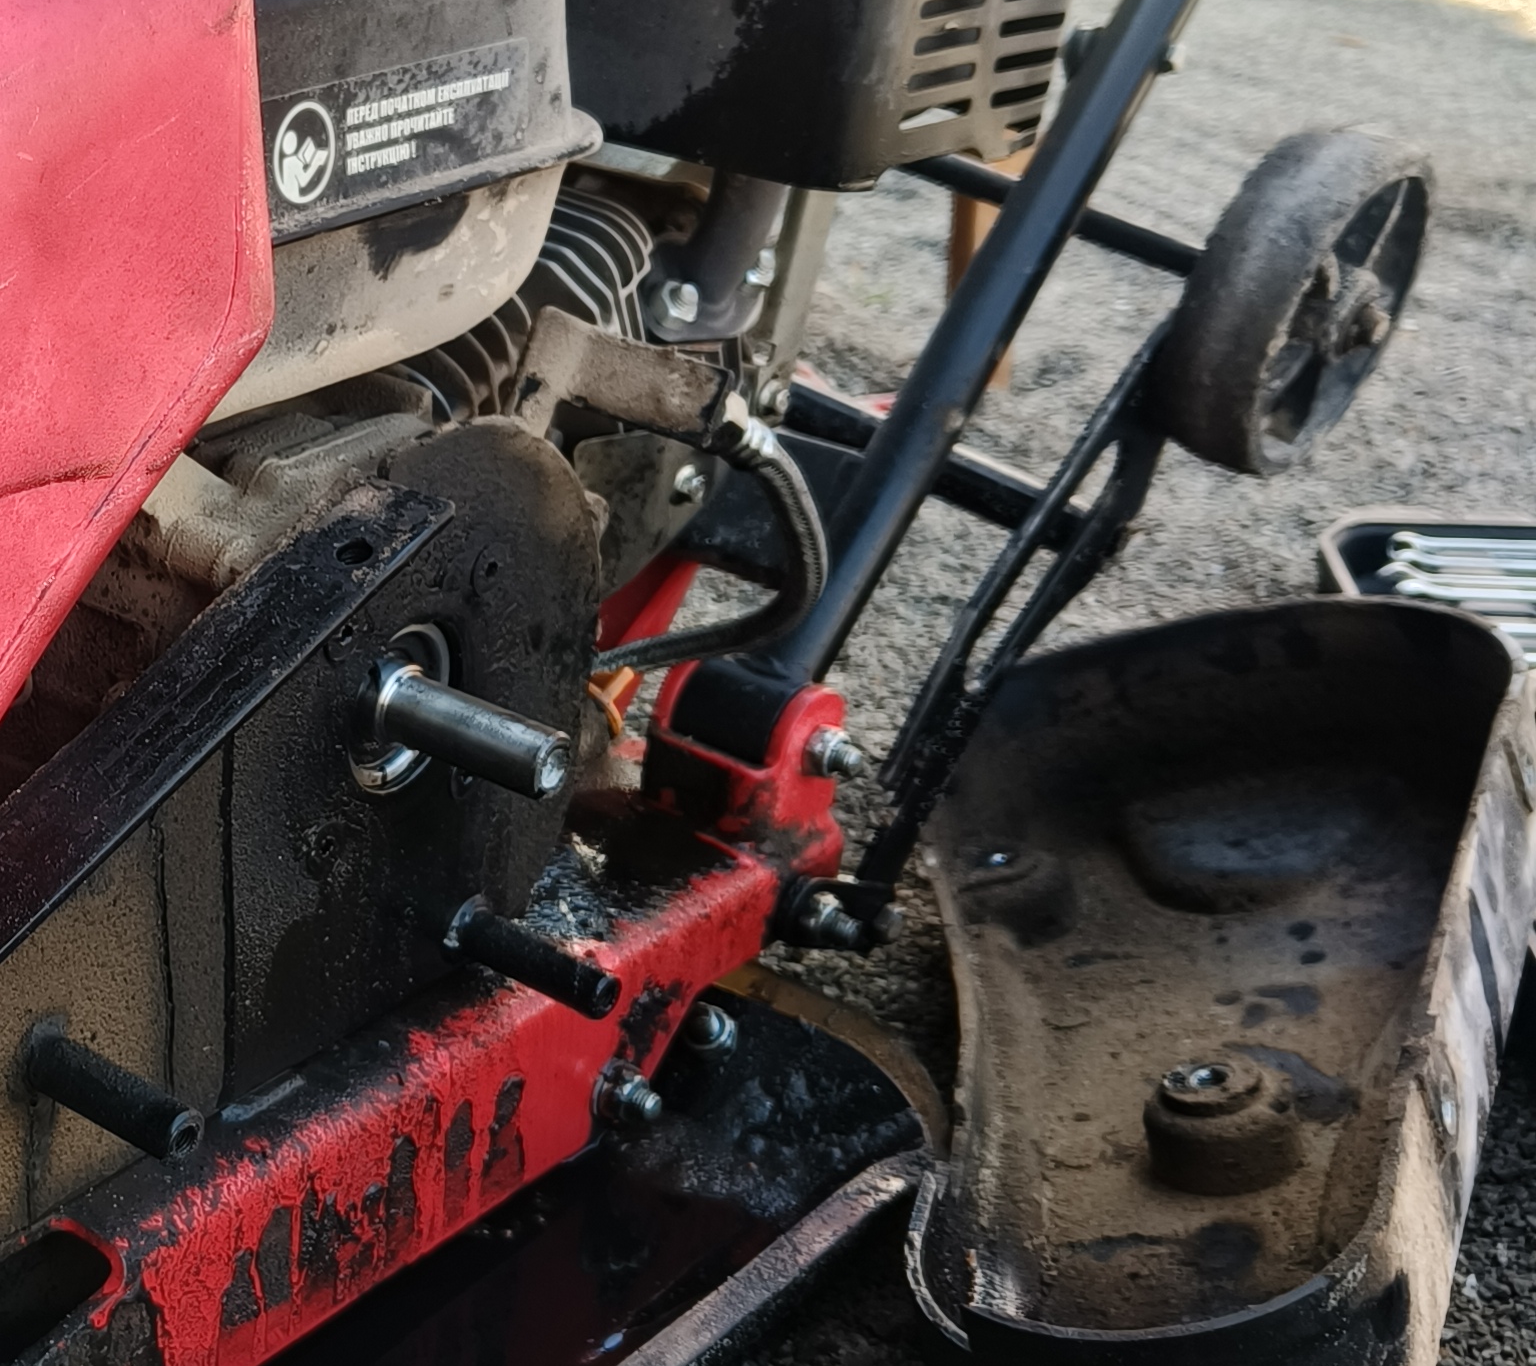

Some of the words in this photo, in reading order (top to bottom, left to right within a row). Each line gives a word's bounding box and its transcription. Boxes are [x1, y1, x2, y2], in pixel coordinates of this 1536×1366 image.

[345, 102, 379, 126] ПЕРЕД
[380, 88, 436, 117] ПОЧАТКОМ
[437, 68, 511, 103] ЕКСПЛУАТАЦІЇ
[346, 124, 389, 151] УВАЖНО
[390, 107, 455, 139] ПРОЧИТАЙТЕ
[346, 143, 410, 176] ІНСТРУКЦІЮ
